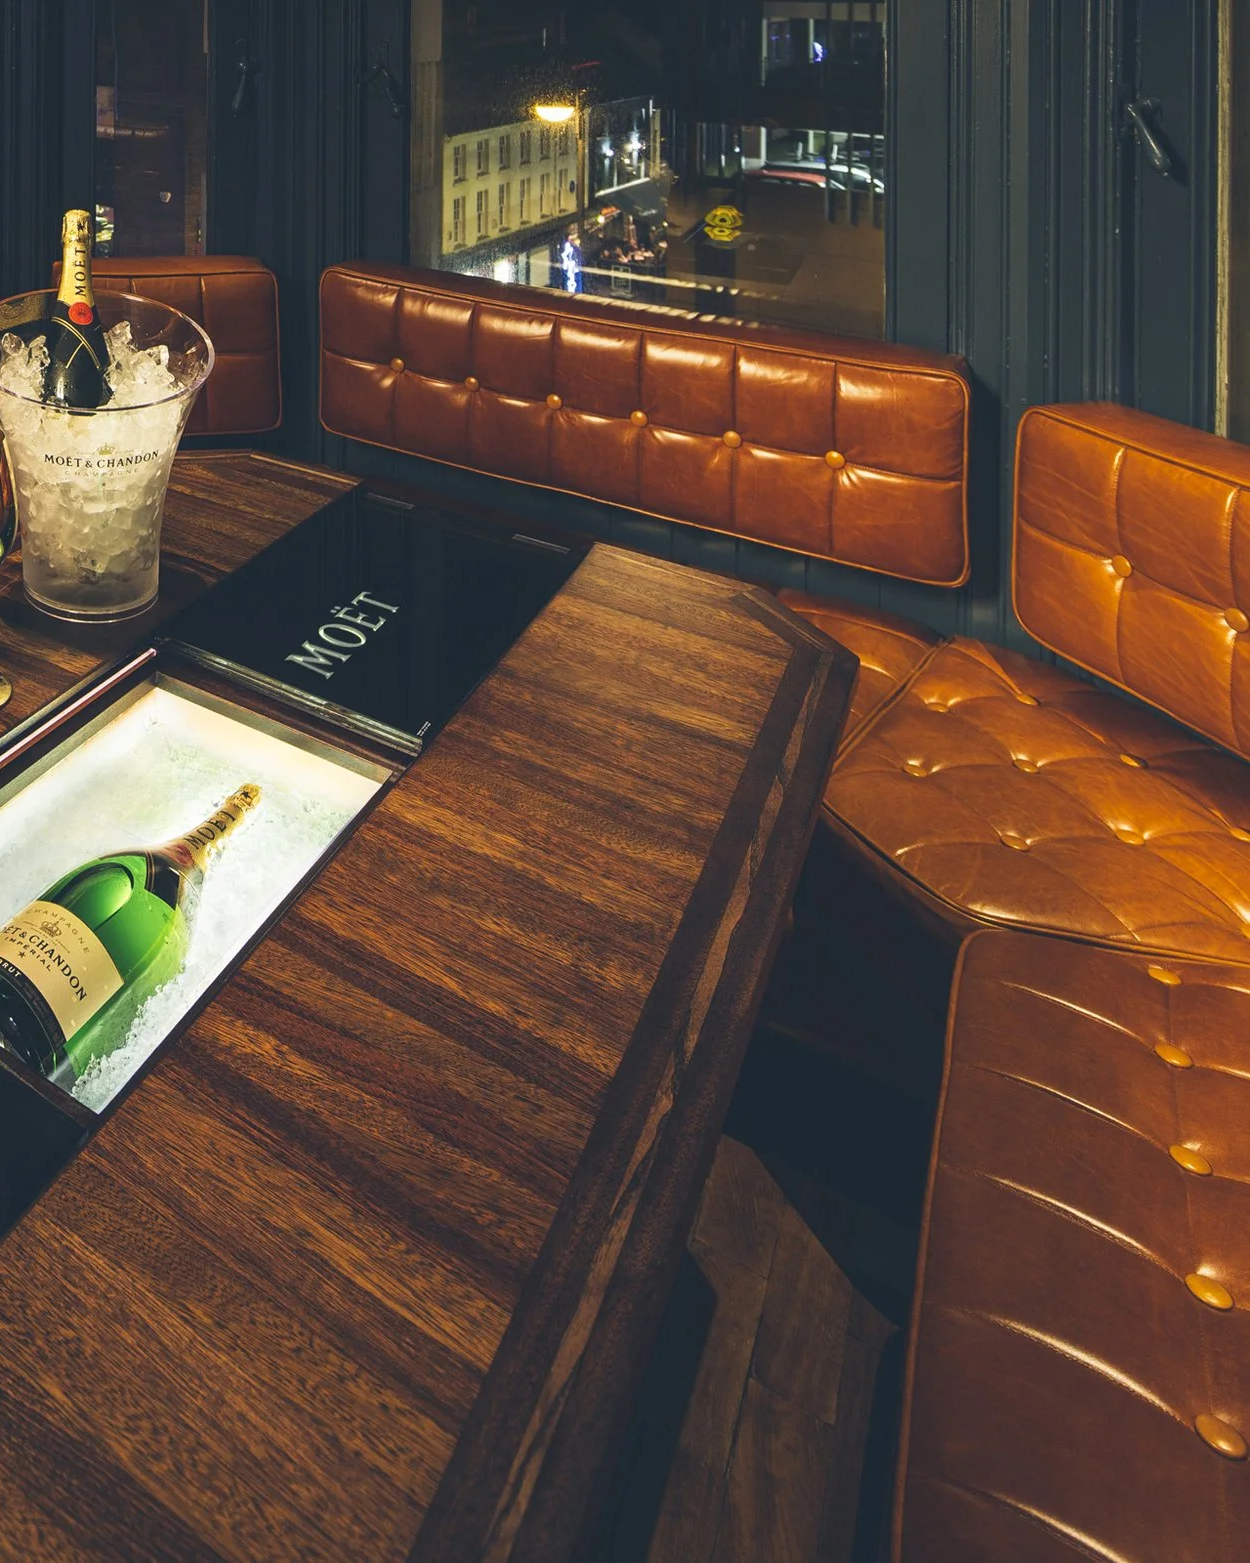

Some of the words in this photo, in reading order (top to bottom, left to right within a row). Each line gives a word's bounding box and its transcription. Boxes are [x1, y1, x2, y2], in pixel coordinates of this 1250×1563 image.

[73, 247, 87, 297] MOËT
[44, 453, 82, 468] MOËT
[85, 459, 93, 468] &
[97, 449, 159, 468] CHANDON
[284, 591, 400, 680] MOËT
[26, 909, 90, 954] CHAMPAGNE
[19, 931, 28, 939] &
[29, 934, 87, 1001] CHANDON
